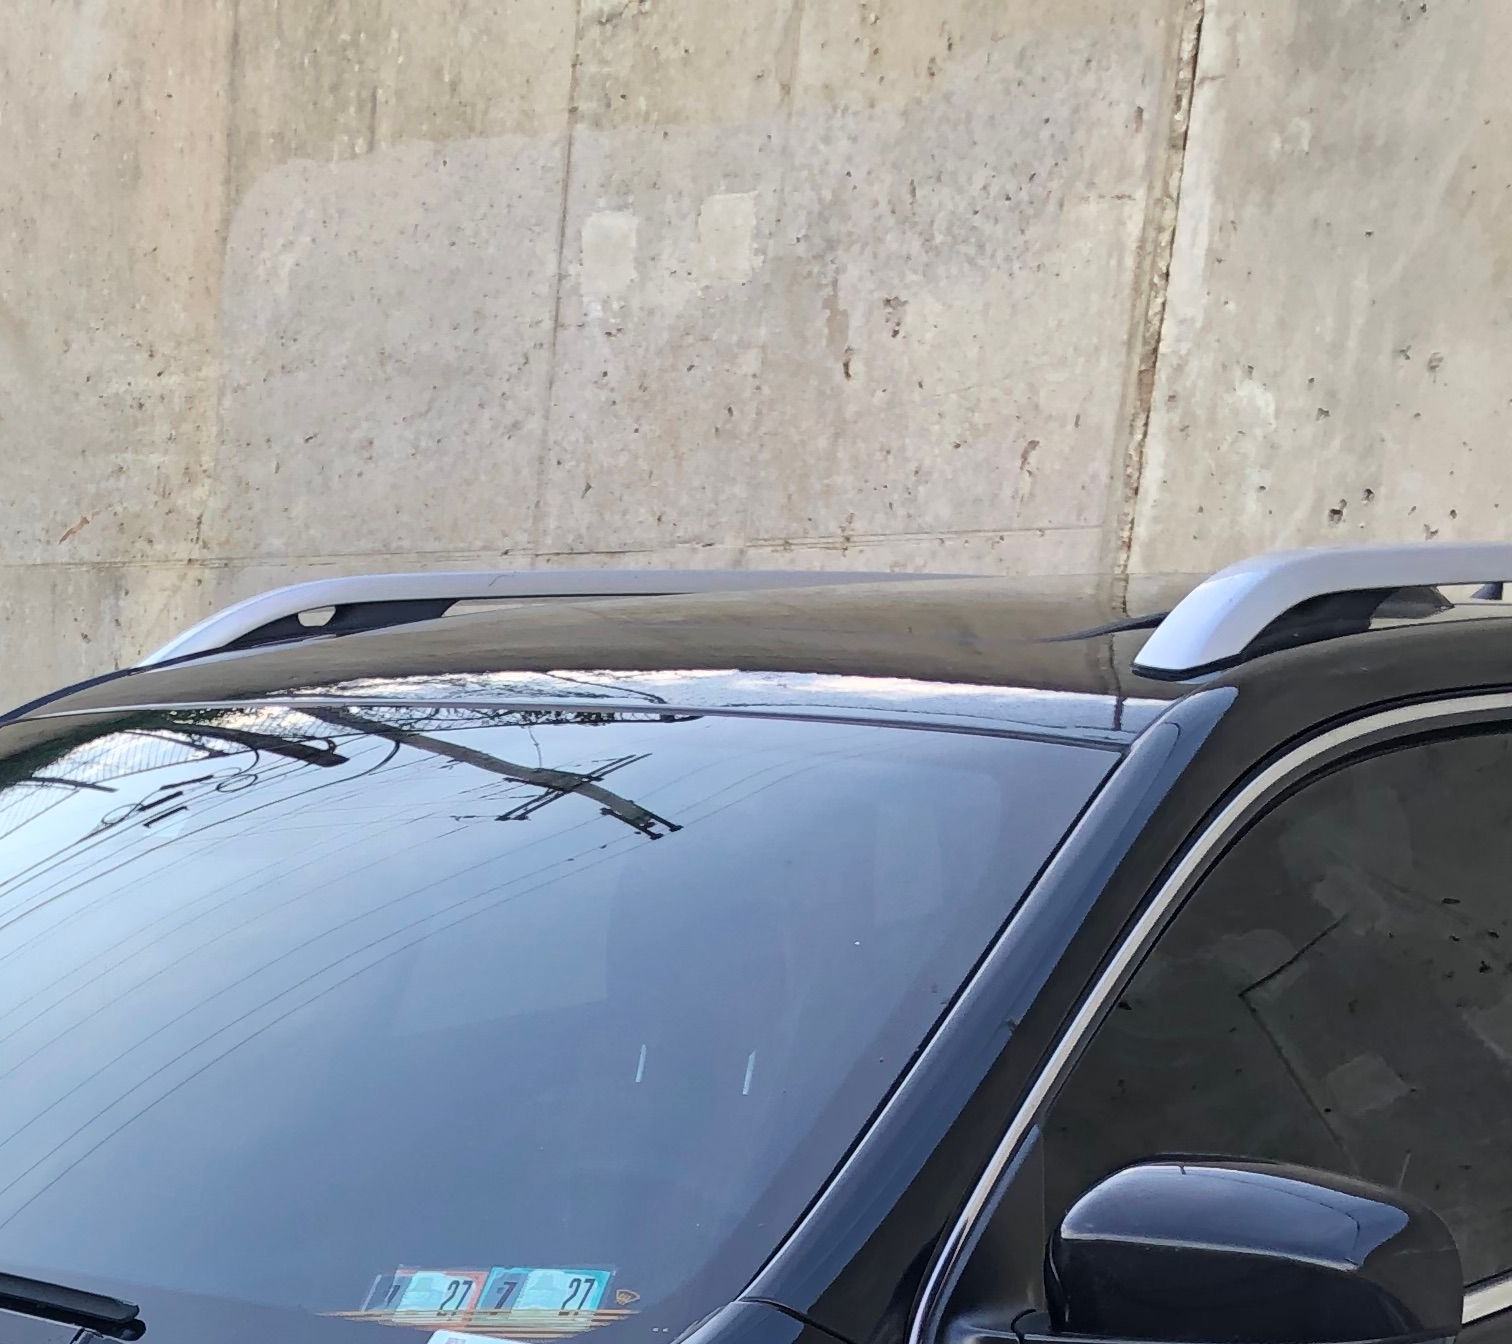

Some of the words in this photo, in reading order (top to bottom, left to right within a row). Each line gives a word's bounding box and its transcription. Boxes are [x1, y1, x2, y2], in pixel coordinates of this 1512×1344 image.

[436, 1280, 473, 1316] 27
[491, 1281, 518, 1315] 7
[558, 1278, 596, 1316] 27
